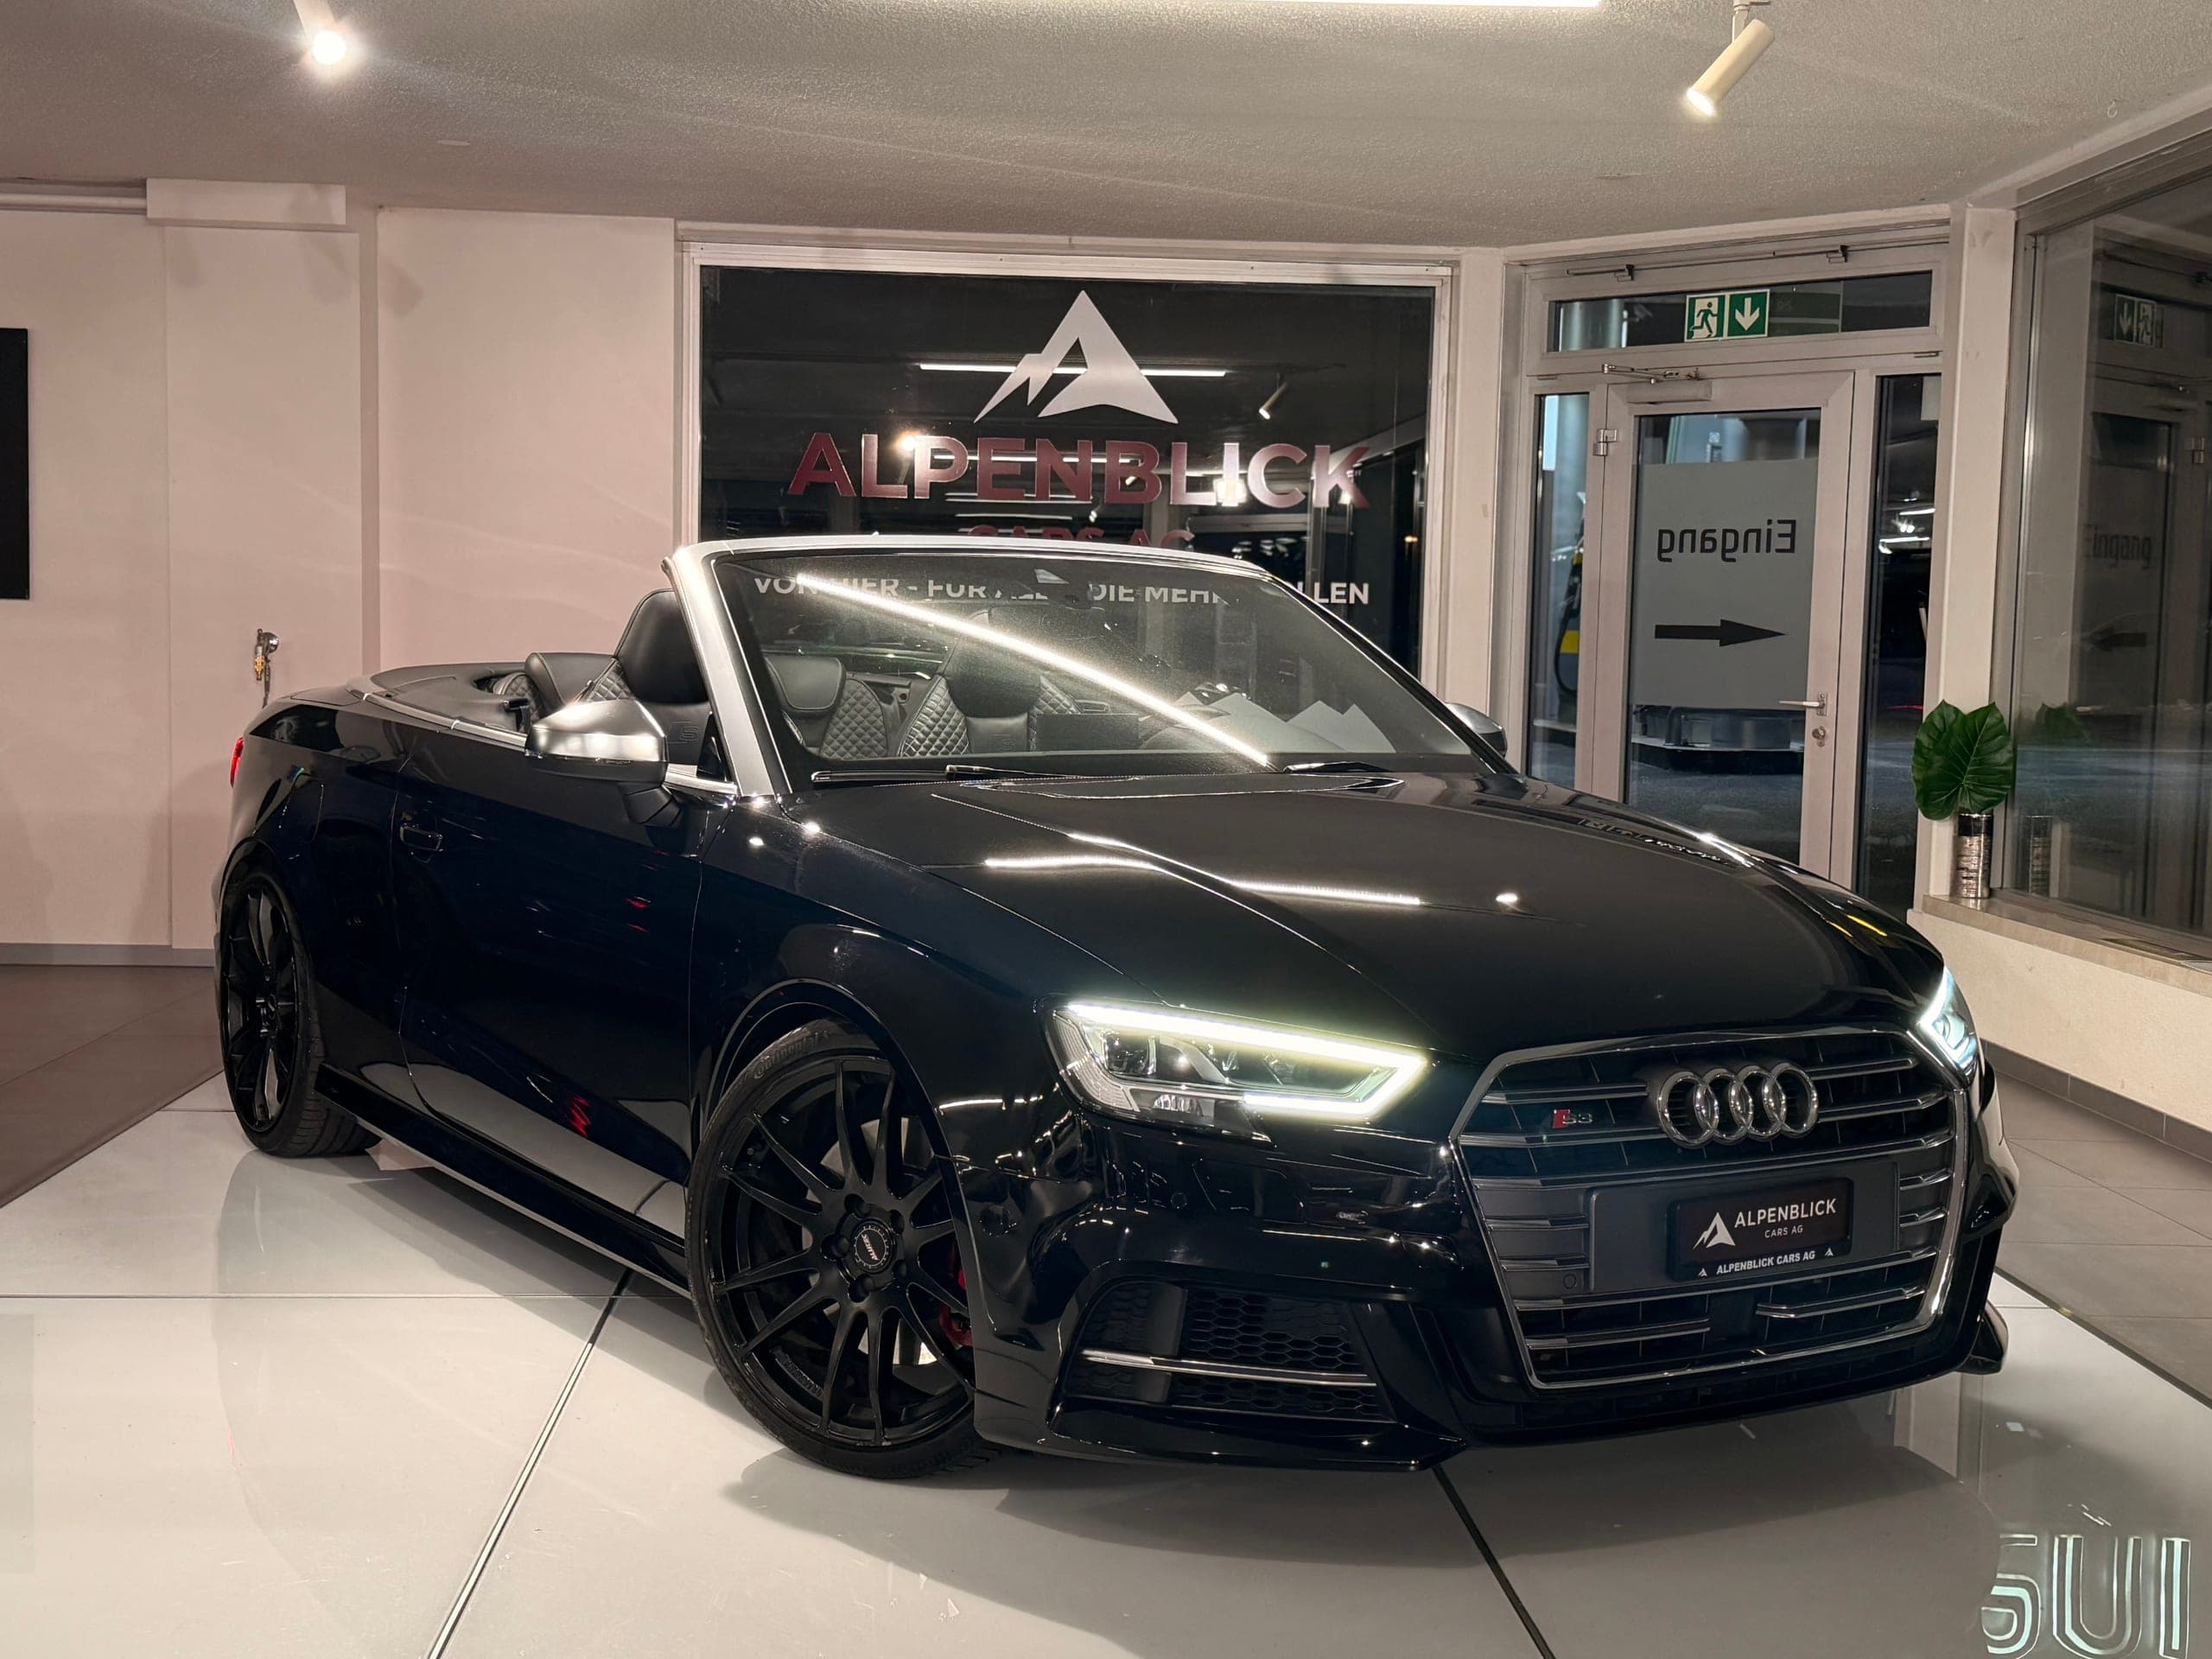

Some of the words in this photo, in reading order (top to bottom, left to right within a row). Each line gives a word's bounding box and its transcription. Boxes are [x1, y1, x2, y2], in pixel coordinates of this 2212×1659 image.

[787, 433, 1371, 509] ALPENBLICK
[1734, 1198, 1837, 1228] ALPENBLICK
[1764, 1227, 1789, 1238] CARS
[1791, 1224, 1803, 1234] AG
[1716, 1256, 1775, 1275] ALPENBLICK
[1777, 1253, 1801, 1266] CARS
[1802, 1250, 1815, 1261] AG
